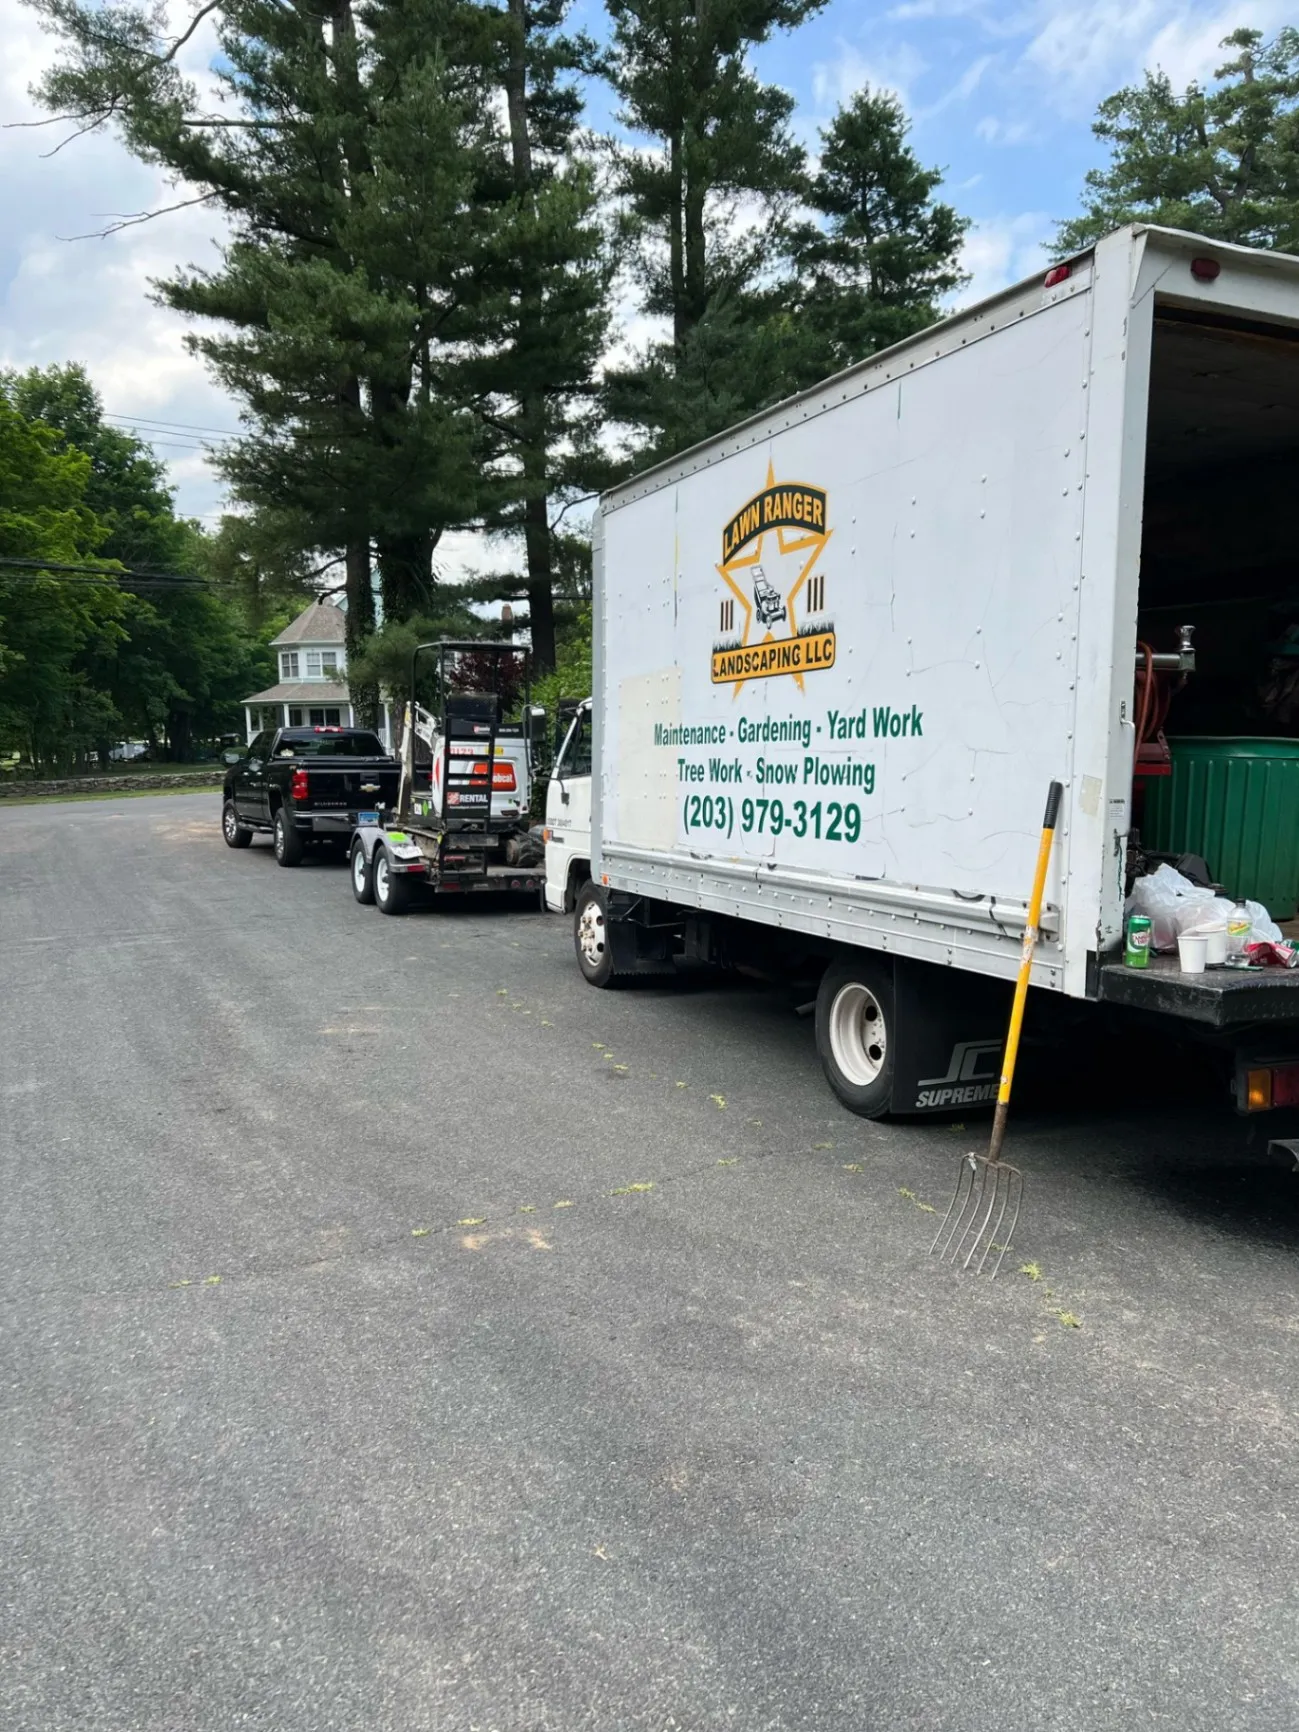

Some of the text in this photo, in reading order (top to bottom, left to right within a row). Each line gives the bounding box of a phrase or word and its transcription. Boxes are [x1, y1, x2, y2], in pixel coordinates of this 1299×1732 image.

[724, 491, 823, 559] LAWN RANGER
[713, 638, 832, 678] LANDSCAPING LLC
[653, 723, 726, 746] Maintenance
[738, 715, 811, 748] Gardening
[827, 708, 866, 739] Yard
[872, 704, 923, 738] Work
[677, 758, 705, 782] Tree
[708, 757, 742, 783] Work
[755, 757, 798, 784] Snow
[803, 756, 875, 795] Plowing
[459, 793, 489, 803] RENTAL
[683, 794, 861, 843] (203) 979-3129
